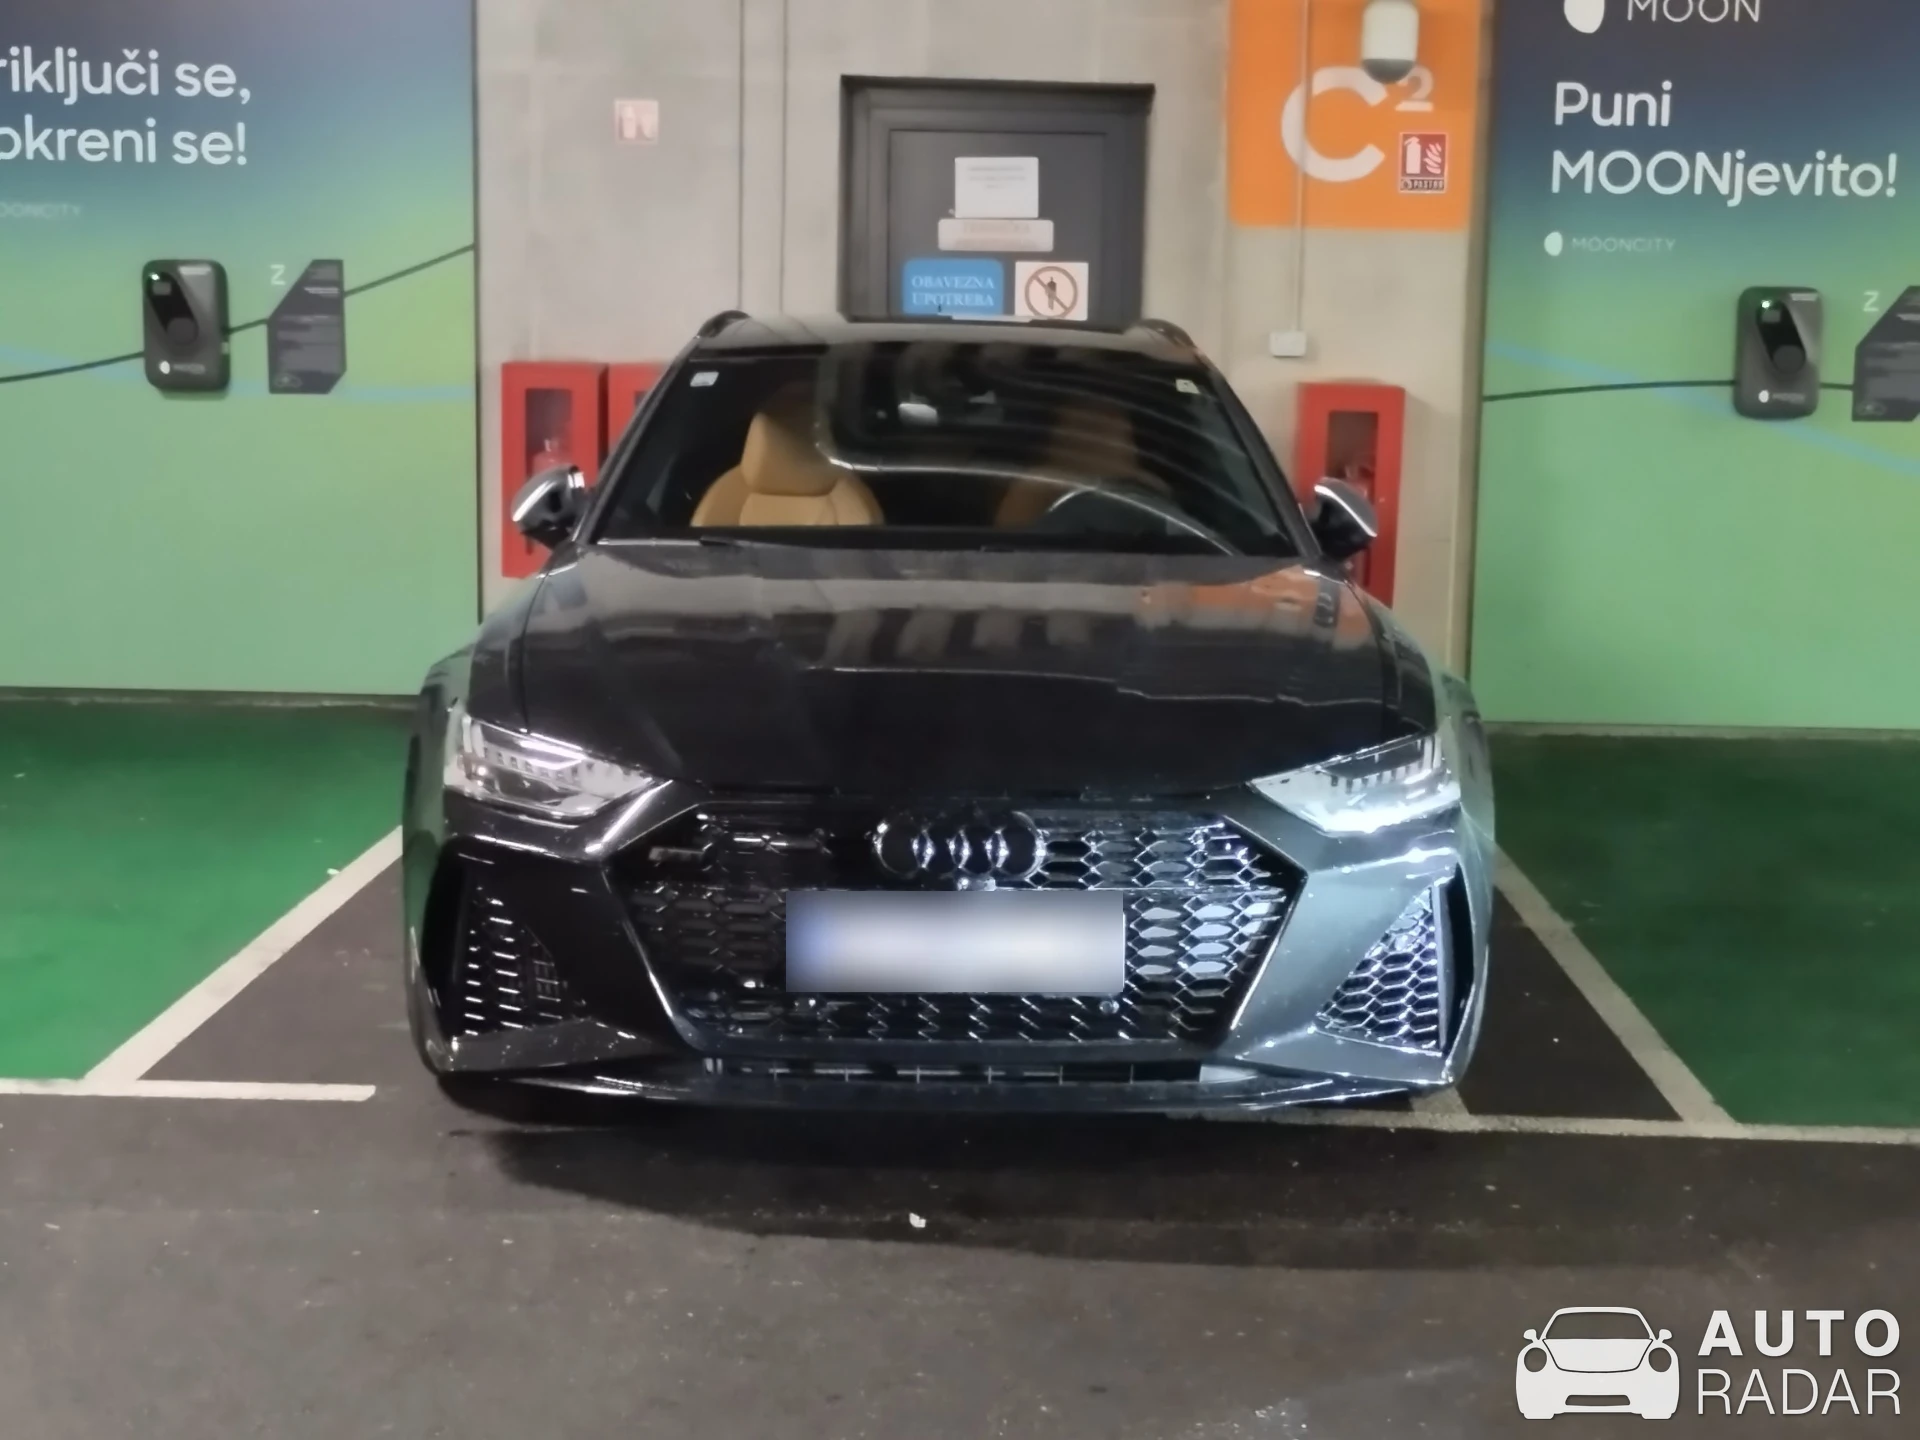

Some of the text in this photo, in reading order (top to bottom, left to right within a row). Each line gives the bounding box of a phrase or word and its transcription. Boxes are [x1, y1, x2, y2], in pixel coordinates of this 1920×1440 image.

[1627, 0, 1760, 23] MOON
[174, 62, 251, 104] se,
[1555, 81, 1672, 127] Puni
[172, 122, 247, 165] se!
[1551, 149, 1897, 207] MOONjevito!
[1572, 237, 1676, 252] MOONCITY
[911, 275, 994, 289] OBAVEZNA
[912, 293, 994, 306] UPOTREBA
